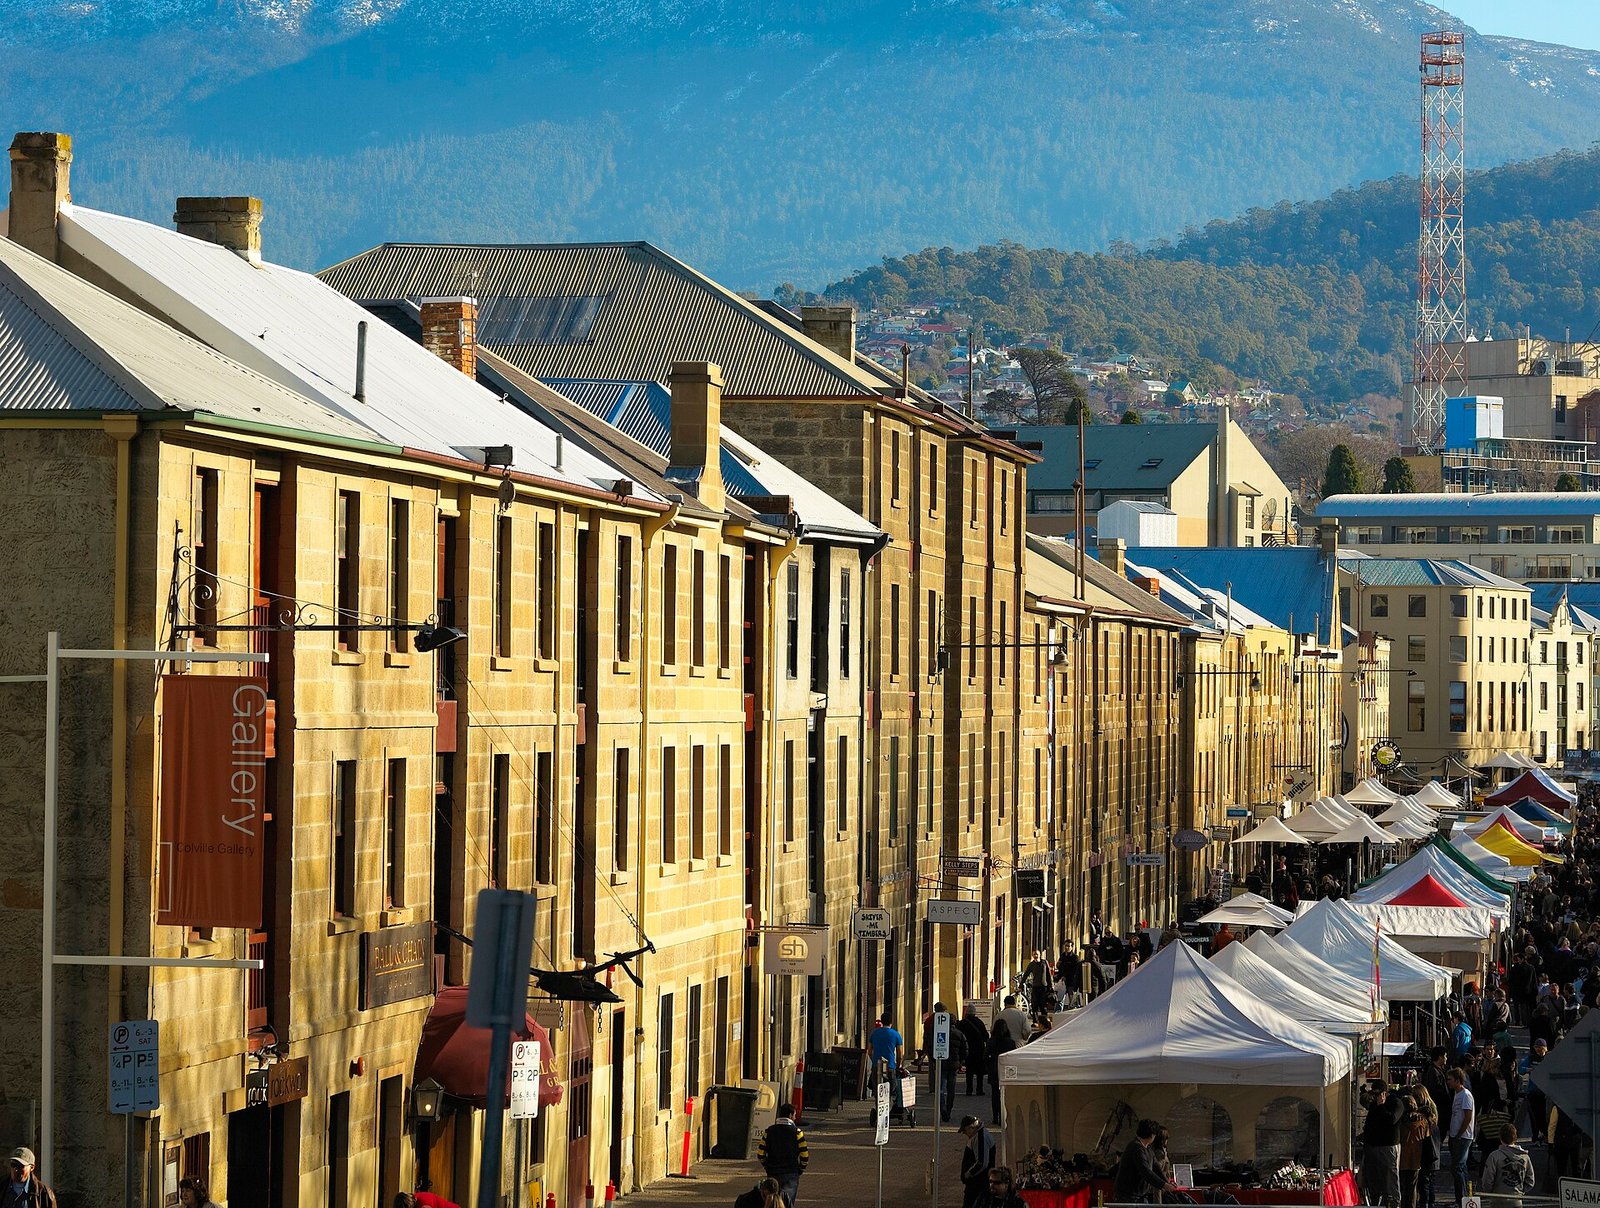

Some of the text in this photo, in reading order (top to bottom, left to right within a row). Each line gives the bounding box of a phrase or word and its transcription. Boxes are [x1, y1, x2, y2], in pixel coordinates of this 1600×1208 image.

[221, 684, 268, 837] Gallery
[176, 842, 255, 856] Colville Gallery
[930, 905, 977, 916] ASPECT
[858, 930, 887, 938] TIMBERS
[781, 939, 805, 956] sh
[374, 944, 393, 970] BALL
[394, 943, 402, 966] &
[937, 1014, 947, 1025] 1P
